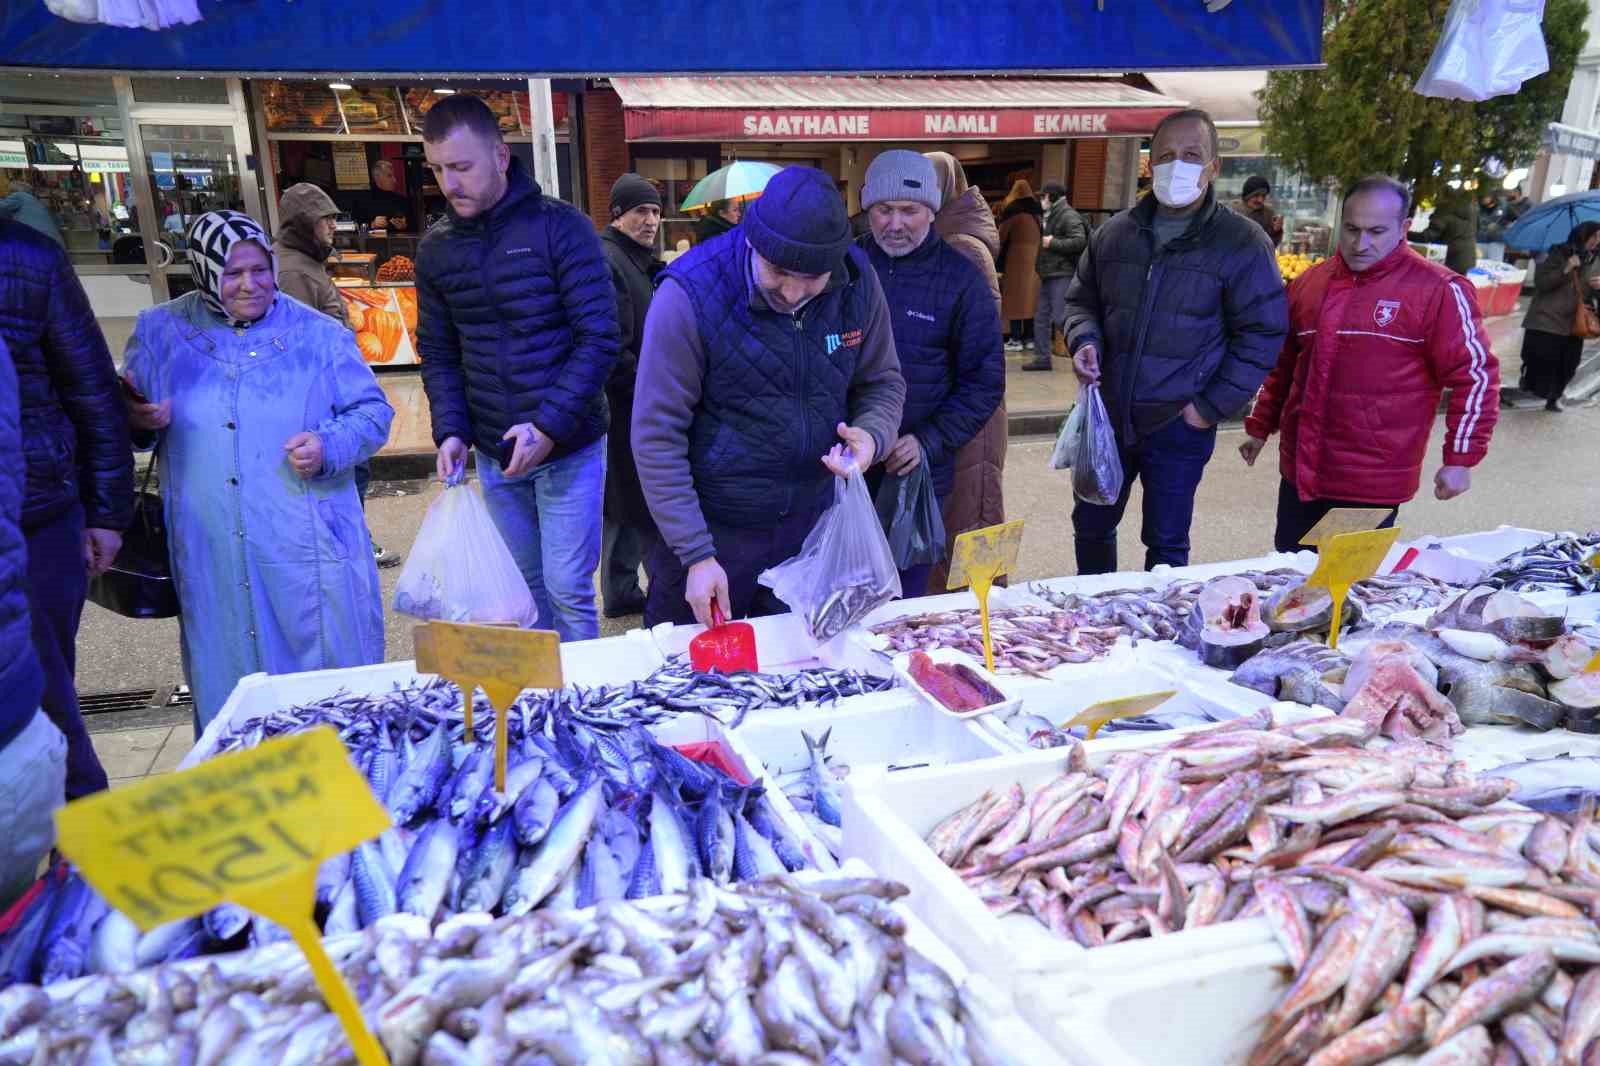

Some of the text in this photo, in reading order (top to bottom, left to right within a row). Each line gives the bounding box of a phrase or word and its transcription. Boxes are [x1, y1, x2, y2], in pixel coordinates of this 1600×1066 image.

[743, 113, 1108, 136] SAATHANE NAMLI EKMEK
